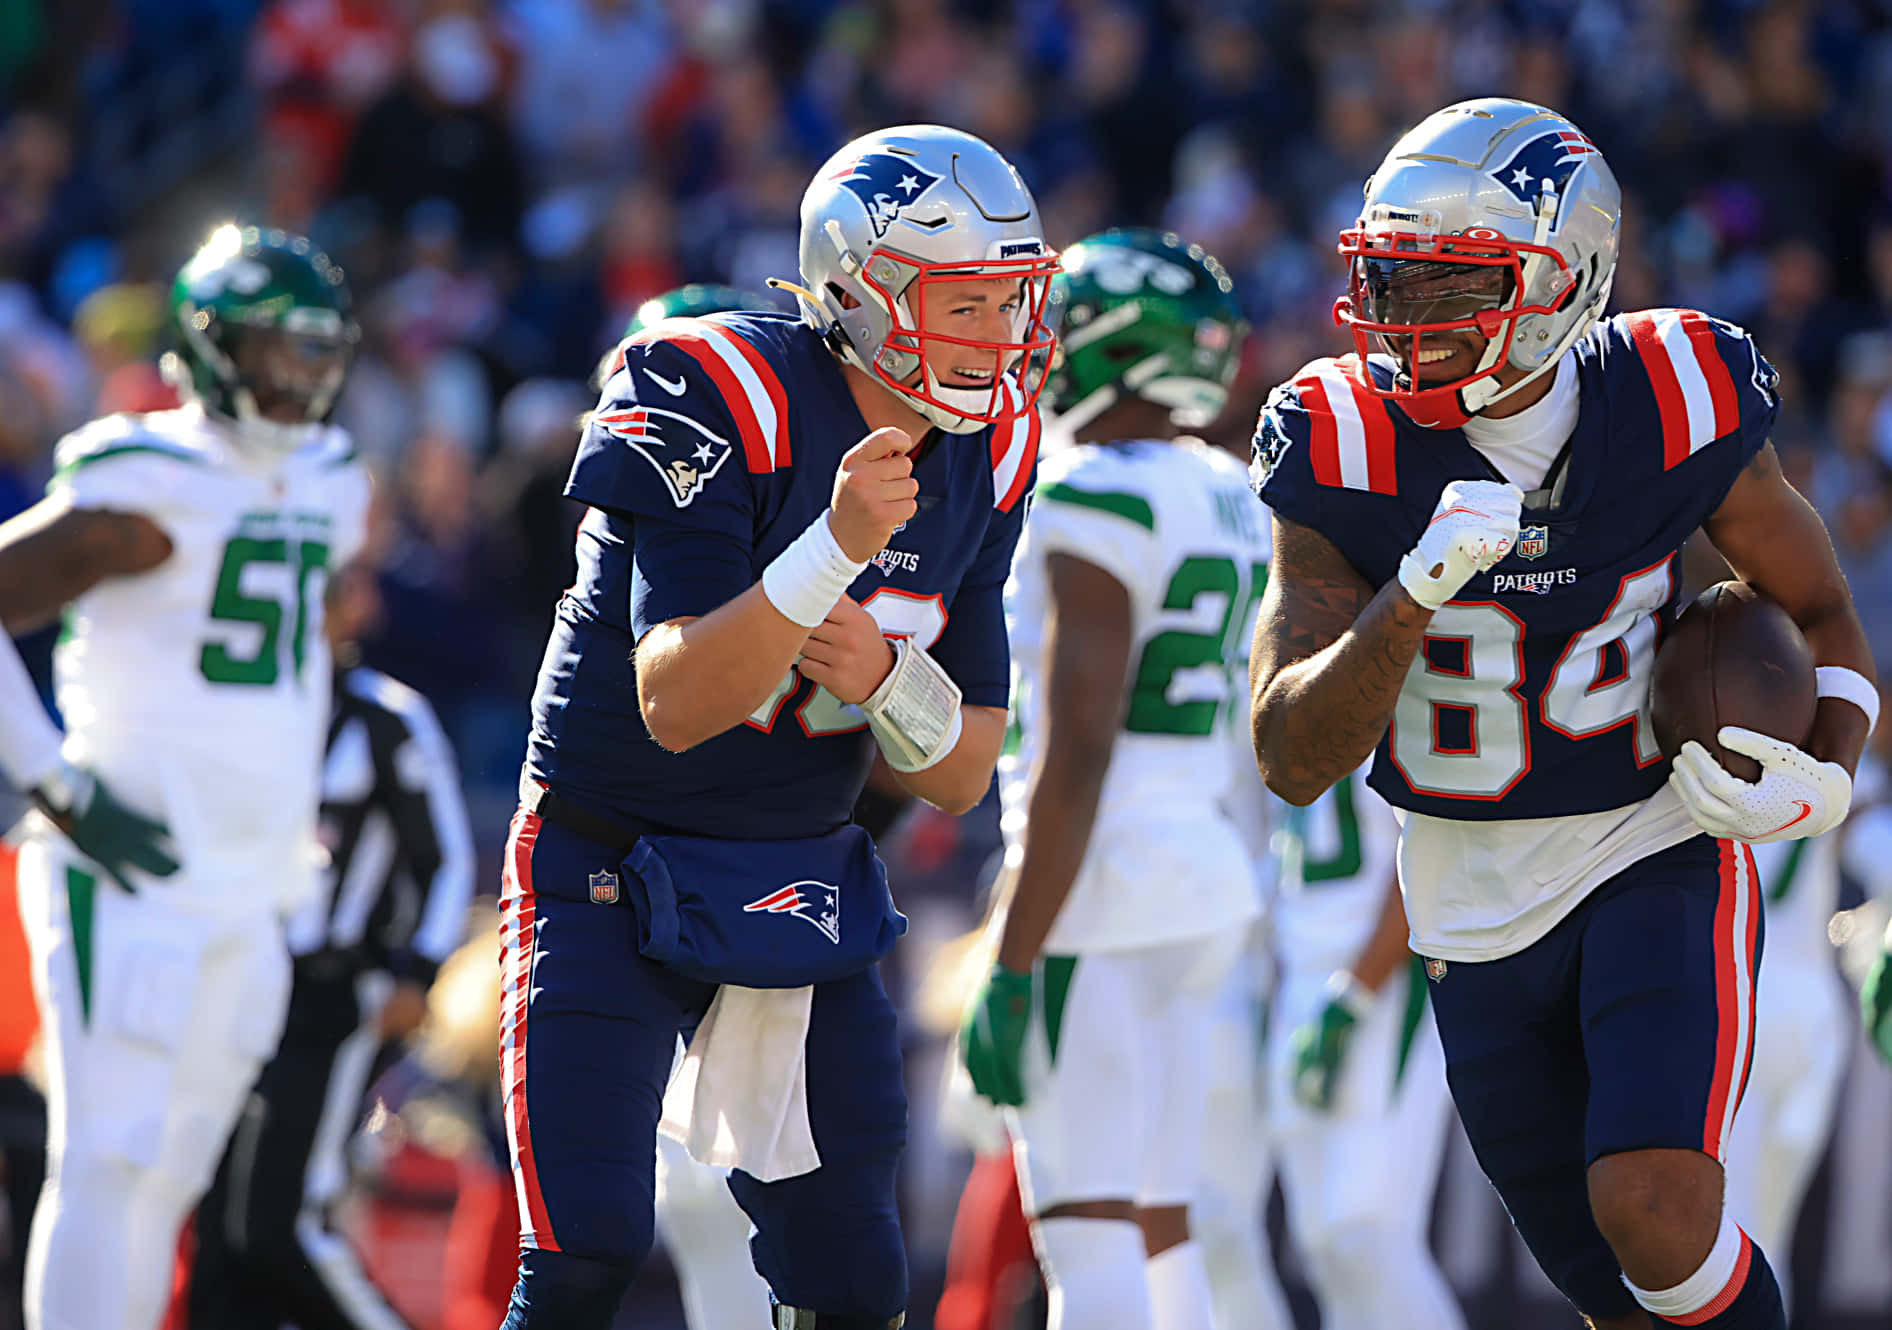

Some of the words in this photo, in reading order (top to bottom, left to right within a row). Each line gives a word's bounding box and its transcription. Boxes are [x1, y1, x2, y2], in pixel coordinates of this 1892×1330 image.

[1493, 568, 1577, 594] PATRIOTS
[1521, 540, 1544, 555] NFL
[1125, 556, 1268, 735] 2
[1389, 551, 1677, 801] 84
